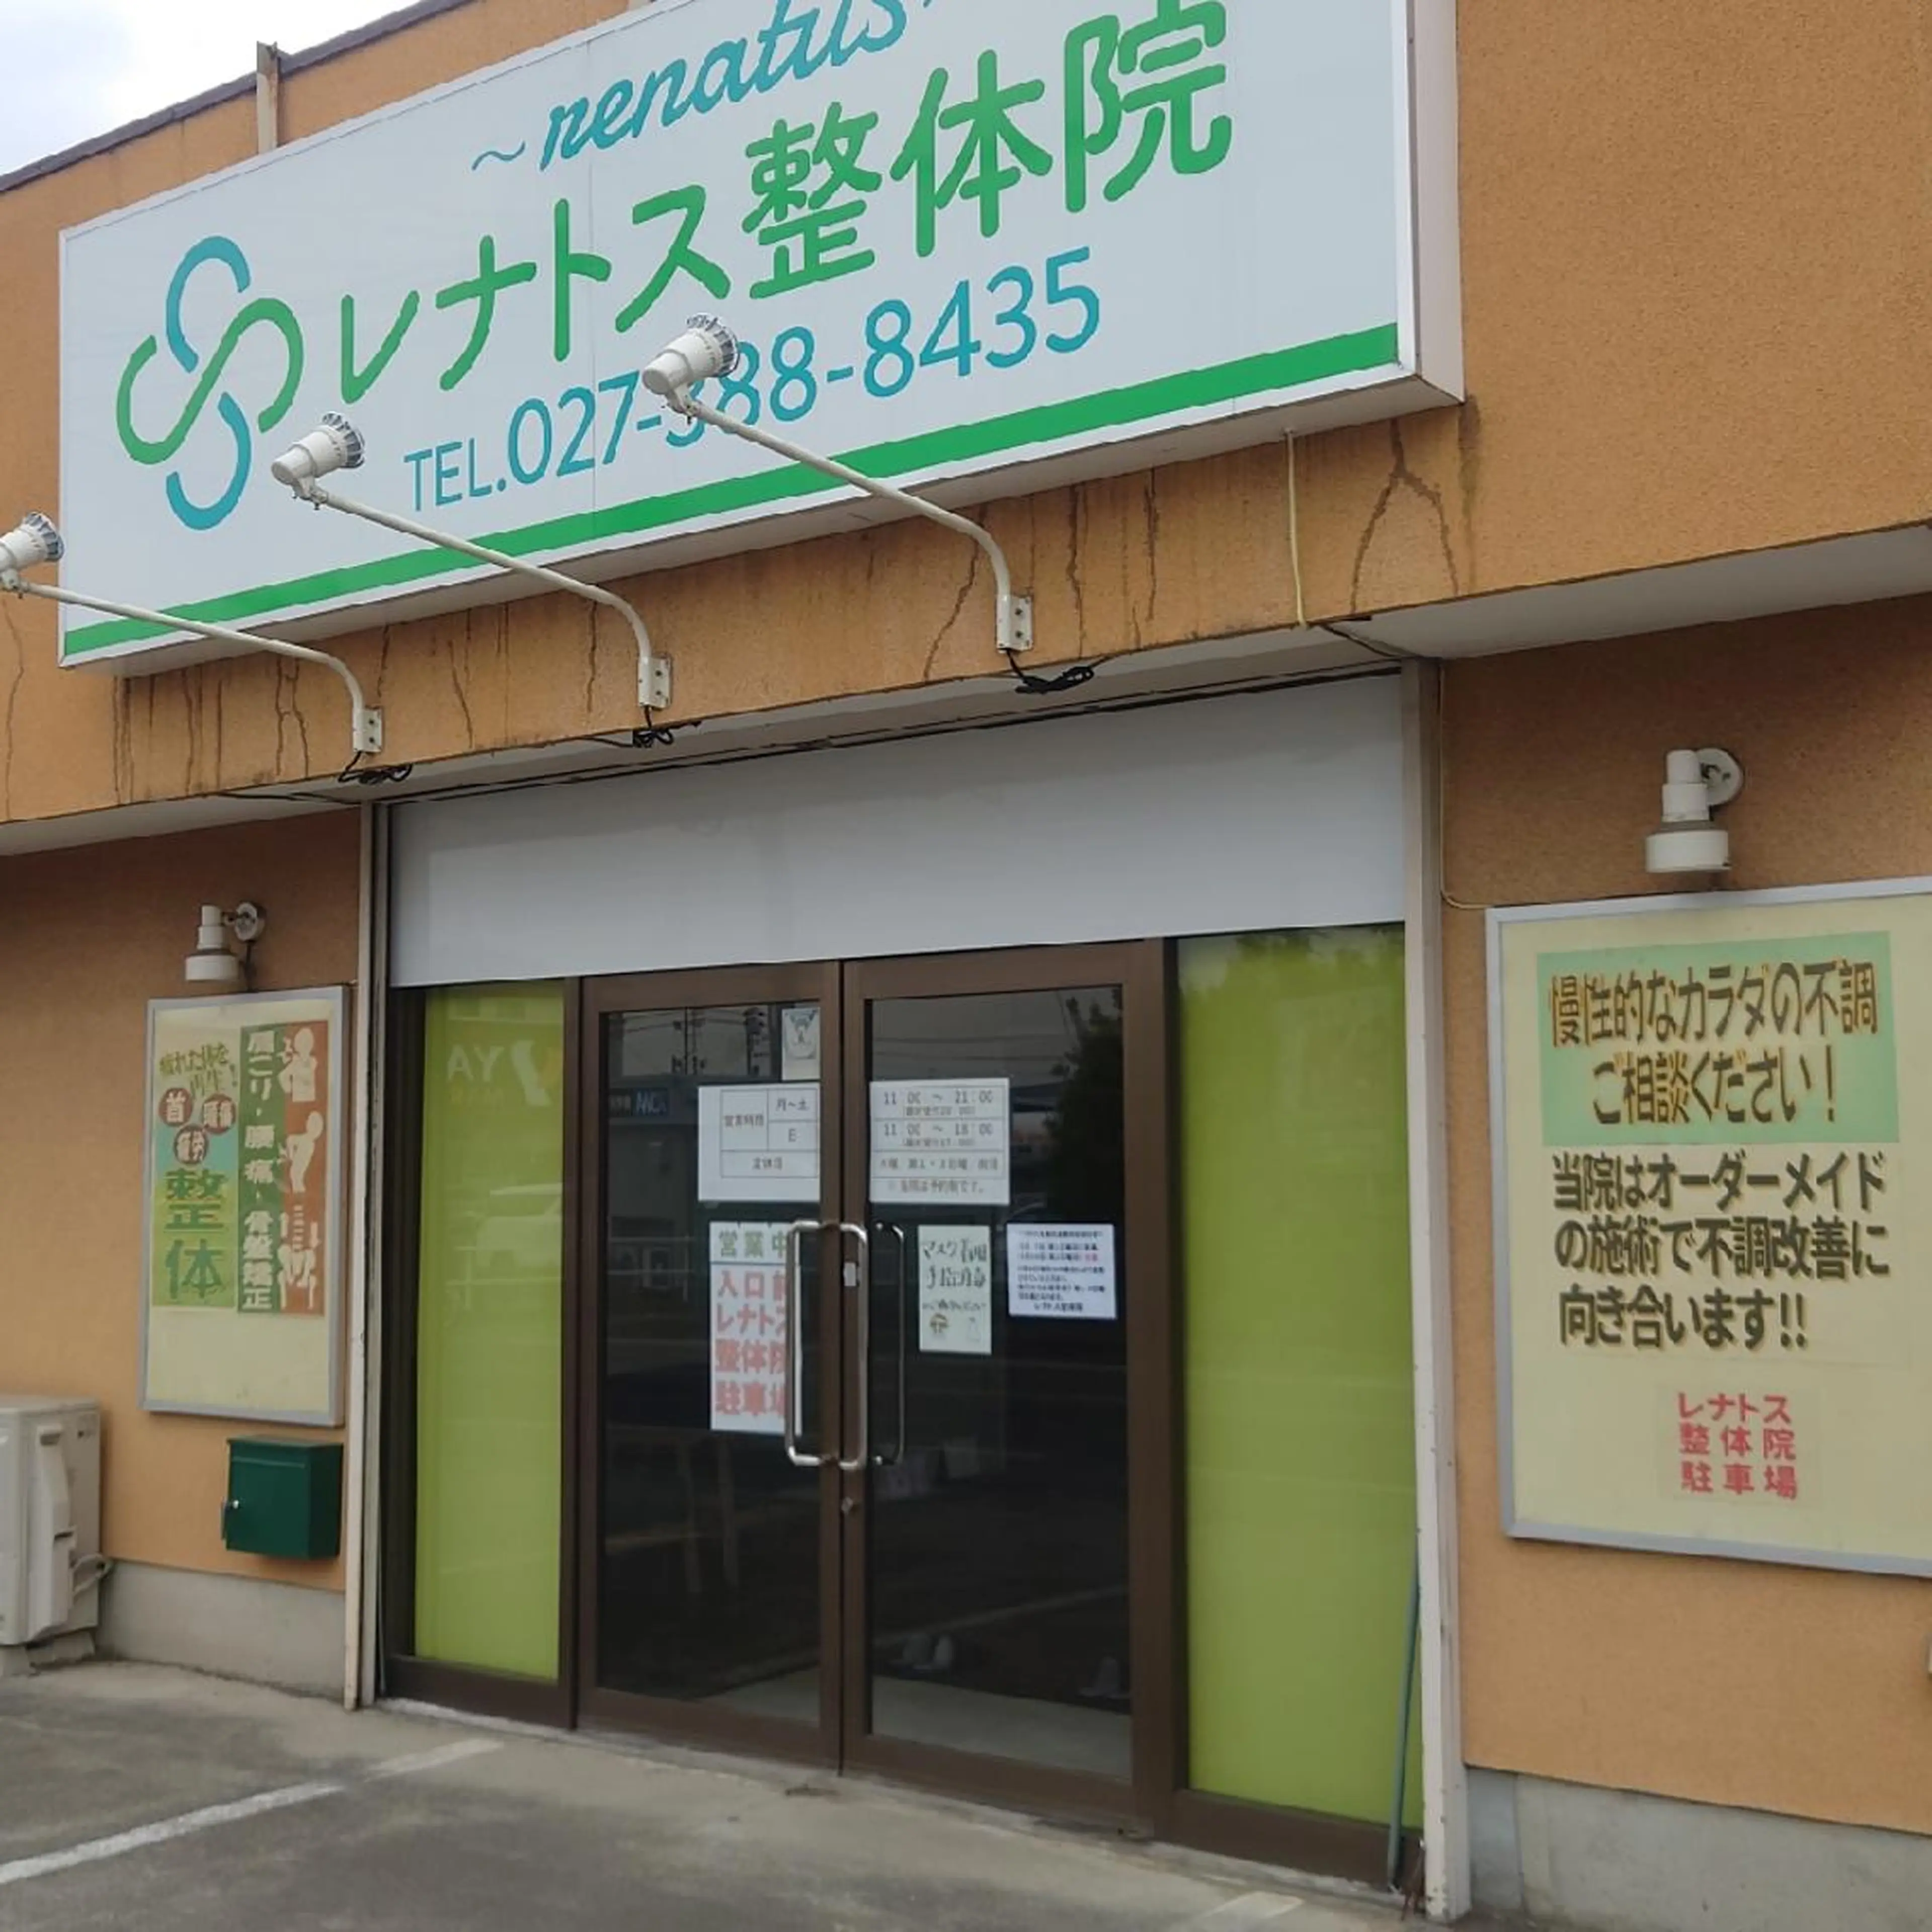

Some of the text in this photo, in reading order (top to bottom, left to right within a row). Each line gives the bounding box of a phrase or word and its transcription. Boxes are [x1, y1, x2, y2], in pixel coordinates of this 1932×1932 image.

[341, 0, 1232, 405] レナトス整体院
[1550, 958, 1879, 1048] 慢性的なカラダの不調
[1593, 1045, 1835, 1124] ご相談ください!
[1552, 1149, 1886, 1210] 当院はオーダーメイド
[165, 1167, 227, 1300] 整体
[1554, 1215, 1890, 1279] の施術で不調改善に
[1559, 1283, 1808, 1349] 向き合います!!
[1678, 1392, 1792, 1424] レナトス
